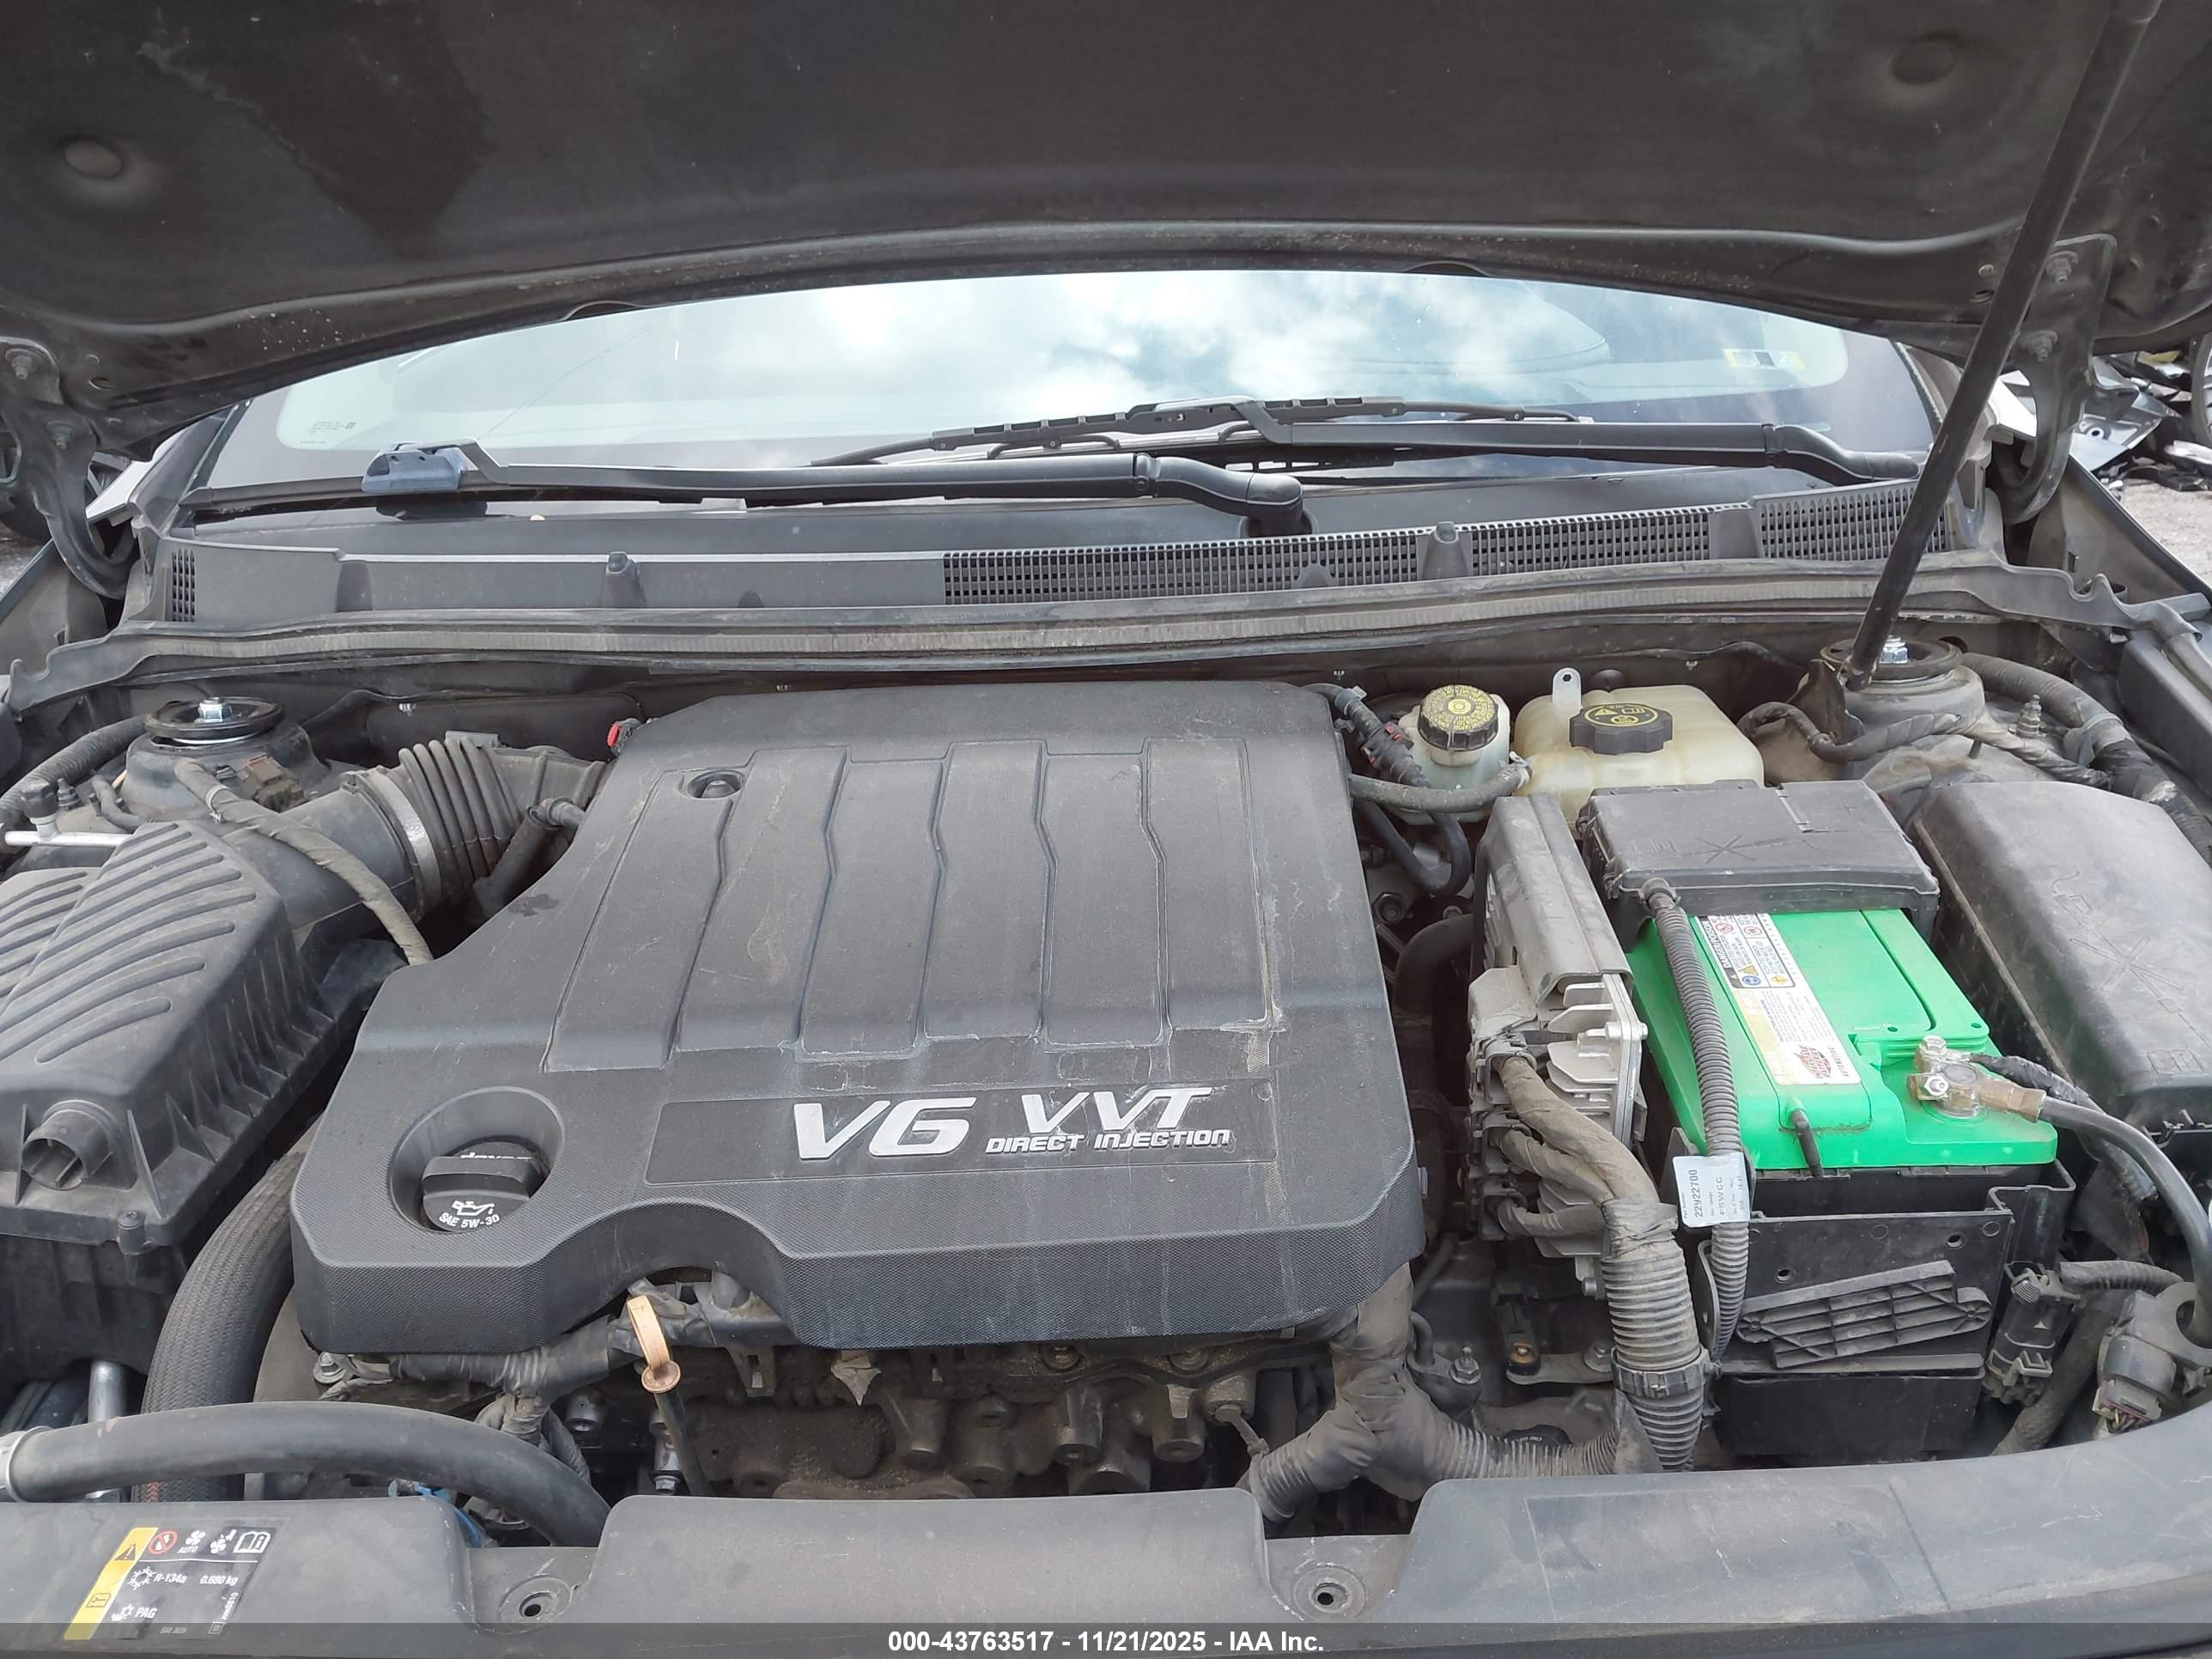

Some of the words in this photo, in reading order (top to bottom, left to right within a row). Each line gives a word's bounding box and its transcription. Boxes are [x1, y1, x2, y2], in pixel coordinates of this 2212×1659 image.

[793, 1097, 977, 1160] V6
[1021, 1086, 1213, 1133] VVT
[985, 1133, 1083, 1154] DIRECT
[1094, 1129, 1231, 1151] INJECTION
[1688, 1169, 1703, 1218] 22922700
[439, 1212, 458, 1227] SAE
[460, 1213, 500, 1229] 5W-30
[177, 1546, 199, 1554] AUTO
[154, 1572, 187, 1584] R-134a
[225, 1575, 239, 1587] kg
[135, 1607, 158, 1620] PAG
